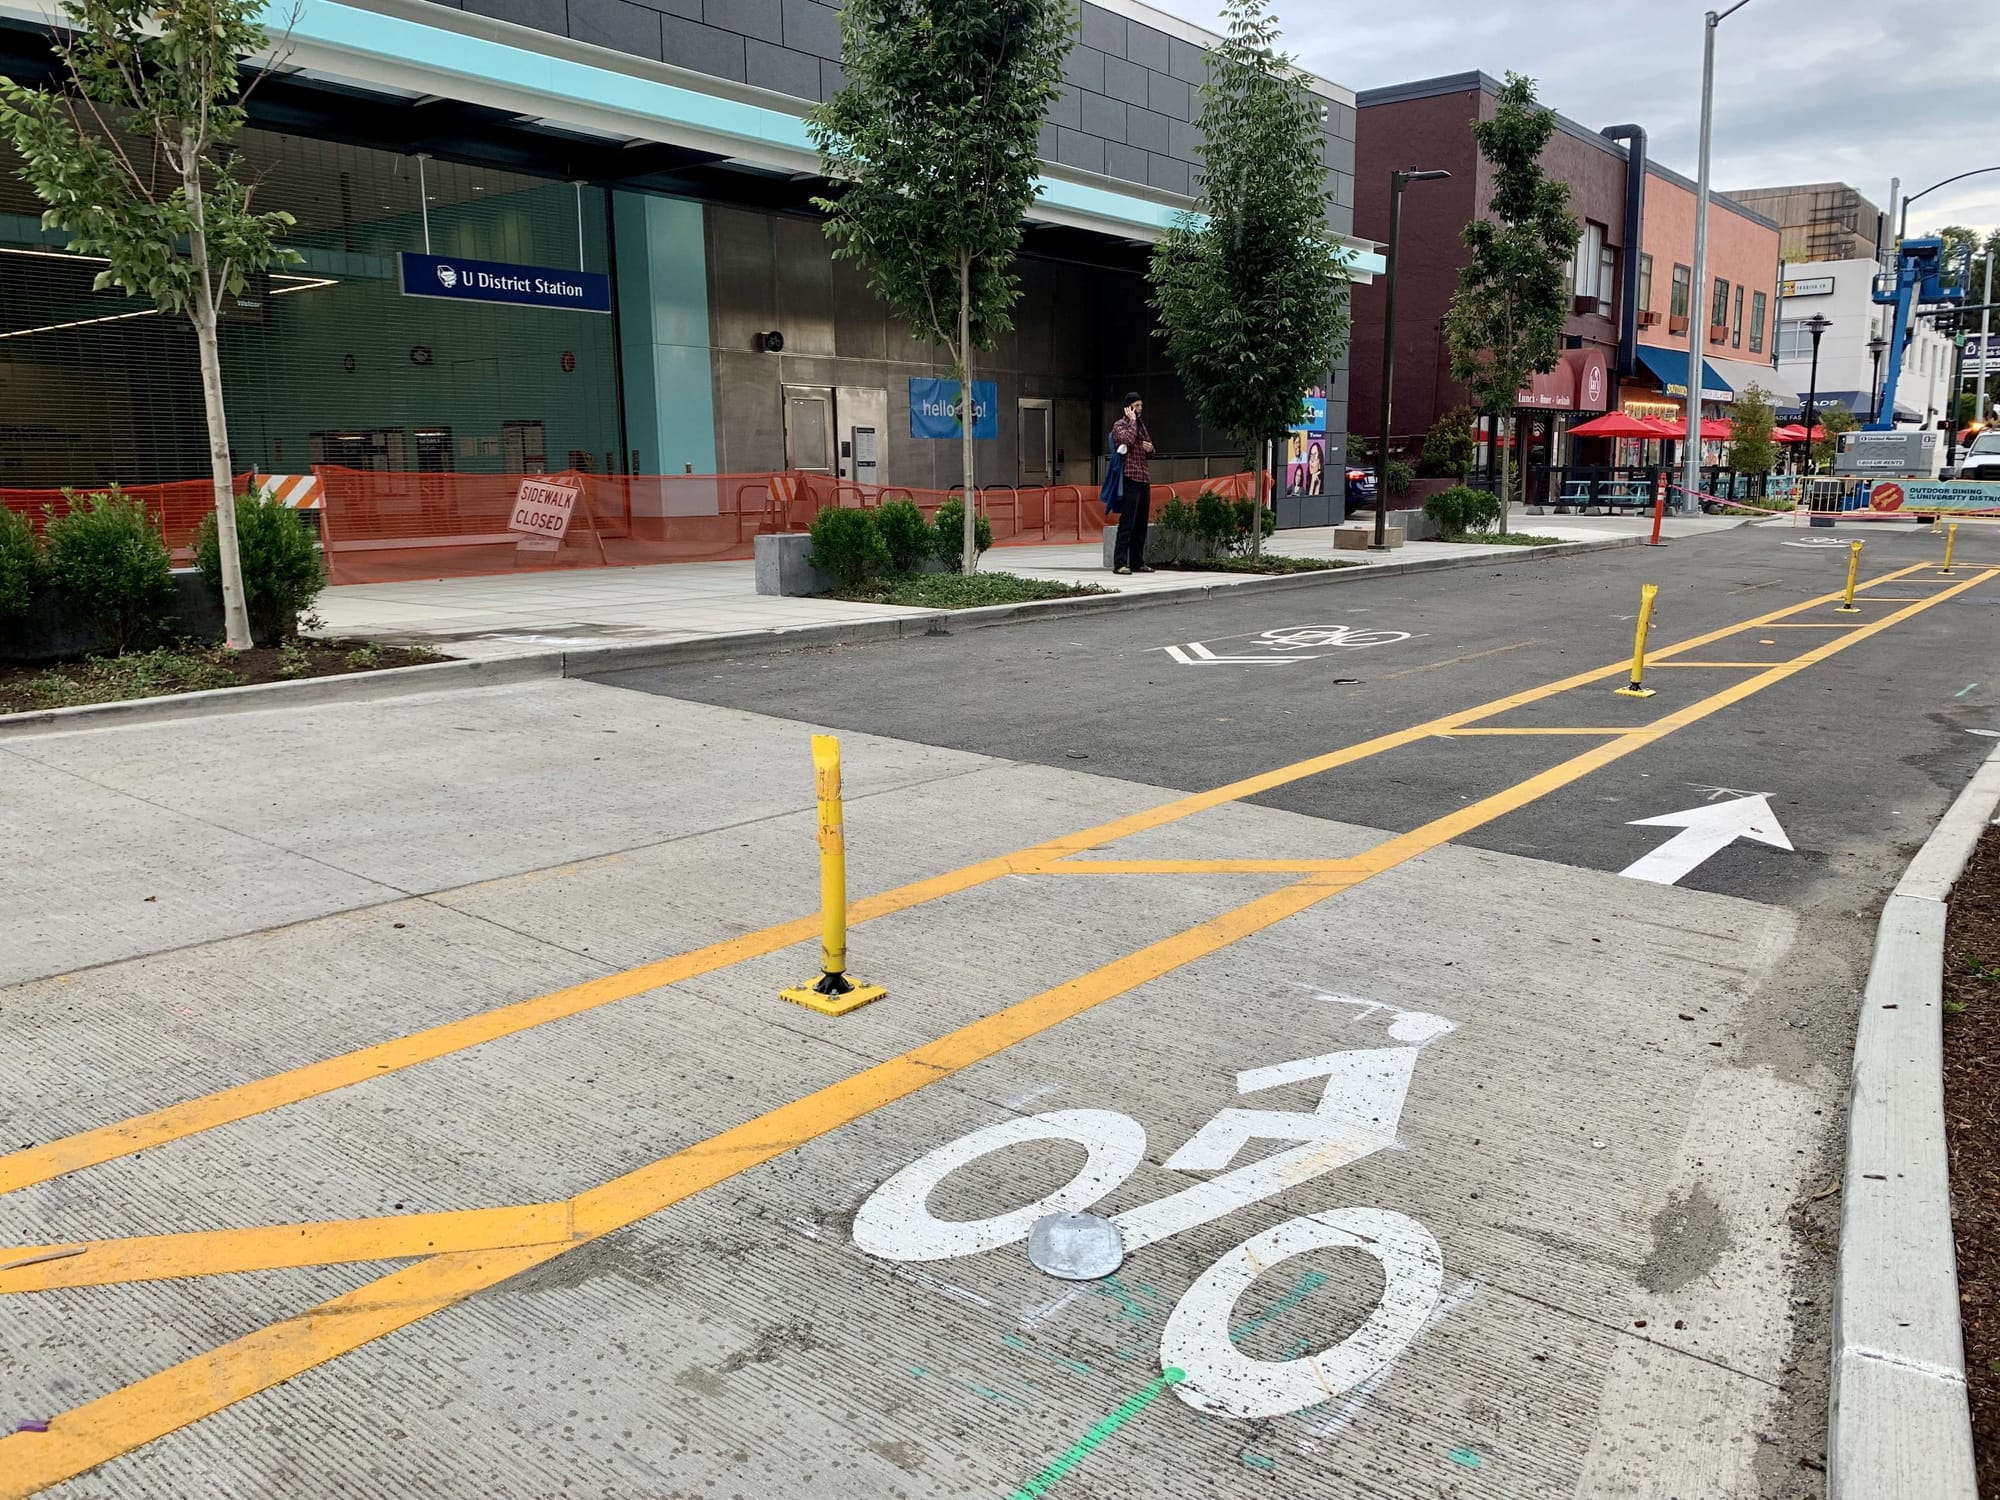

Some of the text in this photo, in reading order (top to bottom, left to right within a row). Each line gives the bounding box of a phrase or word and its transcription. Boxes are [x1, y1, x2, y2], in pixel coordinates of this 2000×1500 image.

[461, 270, 584, 298] U District Station
[922, 399, 955, 417] hello
[520, 486, 574, 509] SIDEWALK
[1909, 487, 1983, 495] OUTDOOR DINING
[1916, 493, 1967, 502] UNIVERSITY
[515, 509, 564, 531] CLOSED
